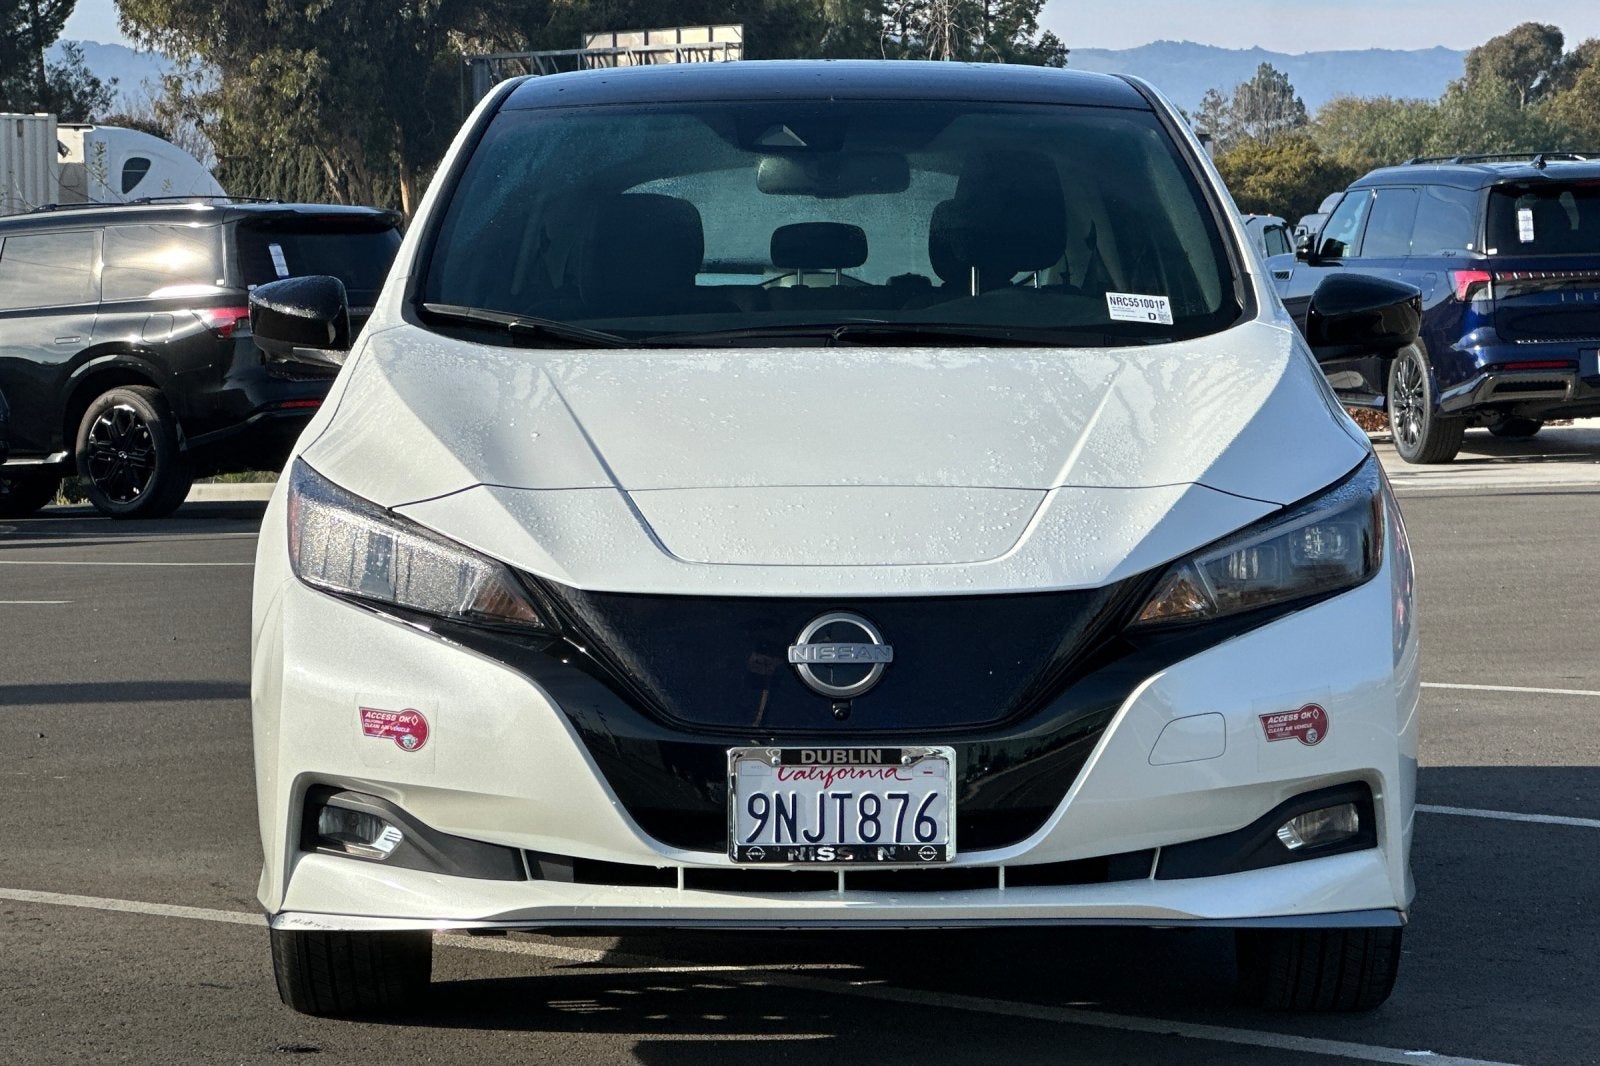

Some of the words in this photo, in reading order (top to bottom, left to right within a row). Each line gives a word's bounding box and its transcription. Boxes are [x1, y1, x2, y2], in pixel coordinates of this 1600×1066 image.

[1109, 296, 1165, 309] NRC551001P
[1148, 312, 1157, 321] D
[791, 646, 890, 660] NISSAN
[365, 711, 397, 721] ACCESS
[398, 714, 412, 723] OK
[1267, 713, 1299, 723] ACCESS
[1301, 711, 1313, 720] OK
[801, 750, 881, 764] DUBLIN
[777, 766, 912, 789] California
[746, 792, 938, 843] 9NJT876
[787, 846, 896, 861] NISSN
